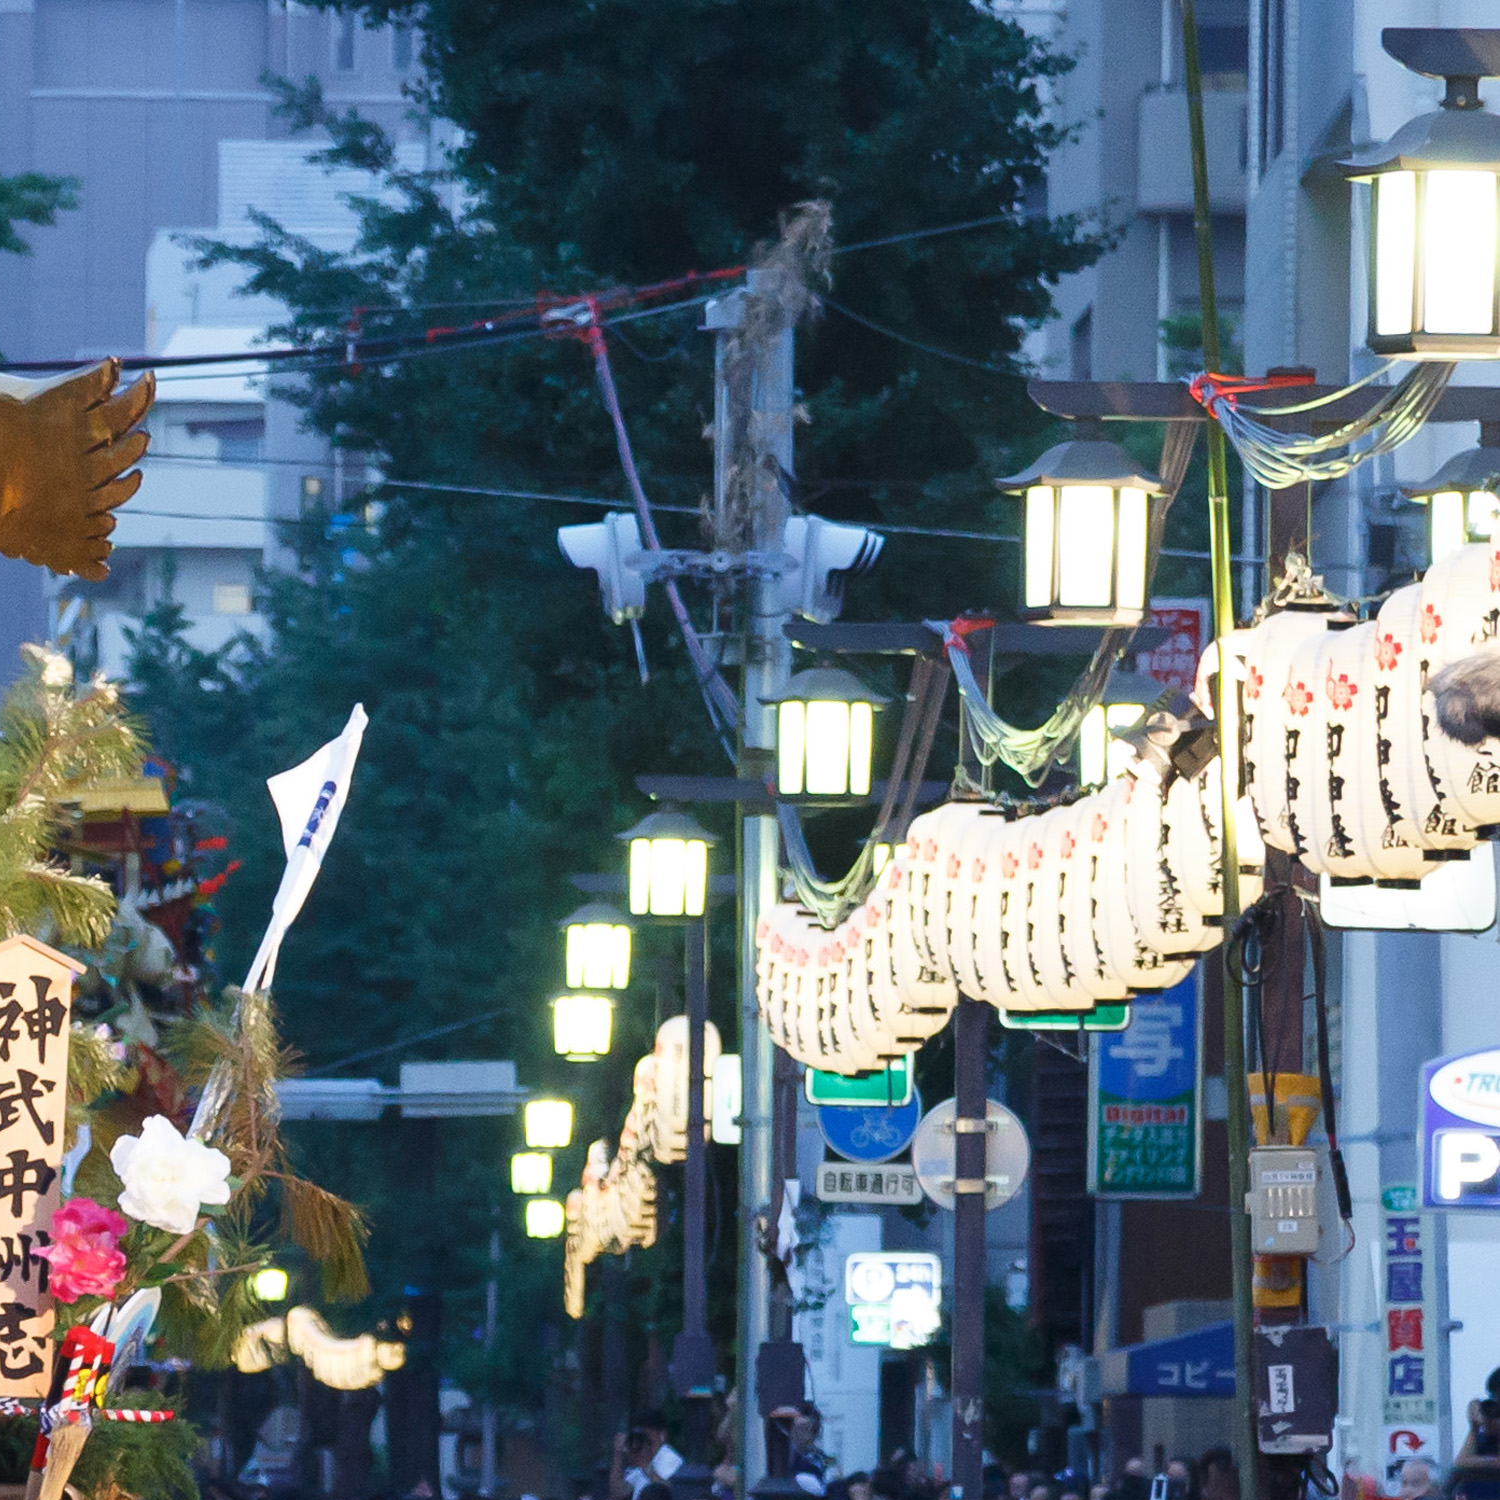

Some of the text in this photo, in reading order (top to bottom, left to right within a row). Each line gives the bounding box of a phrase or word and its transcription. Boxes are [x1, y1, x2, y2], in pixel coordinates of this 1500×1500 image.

[823, 1171, 914, 1196] 自転車通行可
